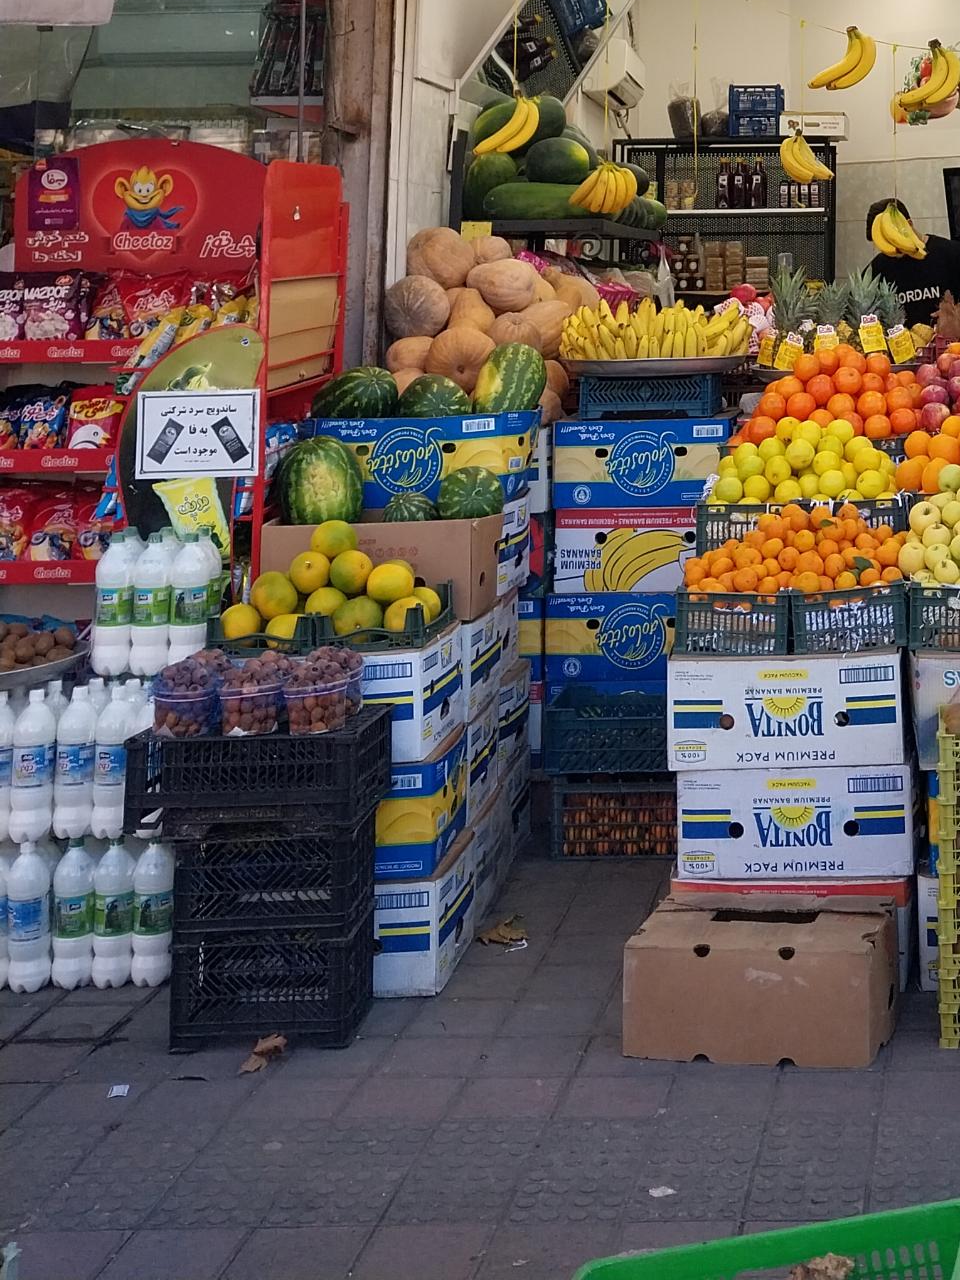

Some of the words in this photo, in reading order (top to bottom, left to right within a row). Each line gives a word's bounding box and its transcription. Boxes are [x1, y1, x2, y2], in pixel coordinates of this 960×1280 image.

[113, 232, 173, 251] Cheetoz
[189, 407, 204, 416] سرد
[206, 404, 237, 416] ساندویچ
[174, 446, 191, 455] است
[193, 447, 217, 456] موجود
[366, 427, 443, 474] golosita
[605, 431, 679, 475] golosita
[560, 549, 602, 558] BANANAS
[561, 560, 602, 569] PREMIUM
[595, 603, 670, 648] golosita
[744, 701, 824, 737] BONITA
[736, 752, 769, 763] PACK
[775, 750, 835, 761] PREMIUM
[753, 810, 833, 847] BONITA
[744, 862, 777, 873] PACK
[783, 861, 844, 871] PREMIUM
